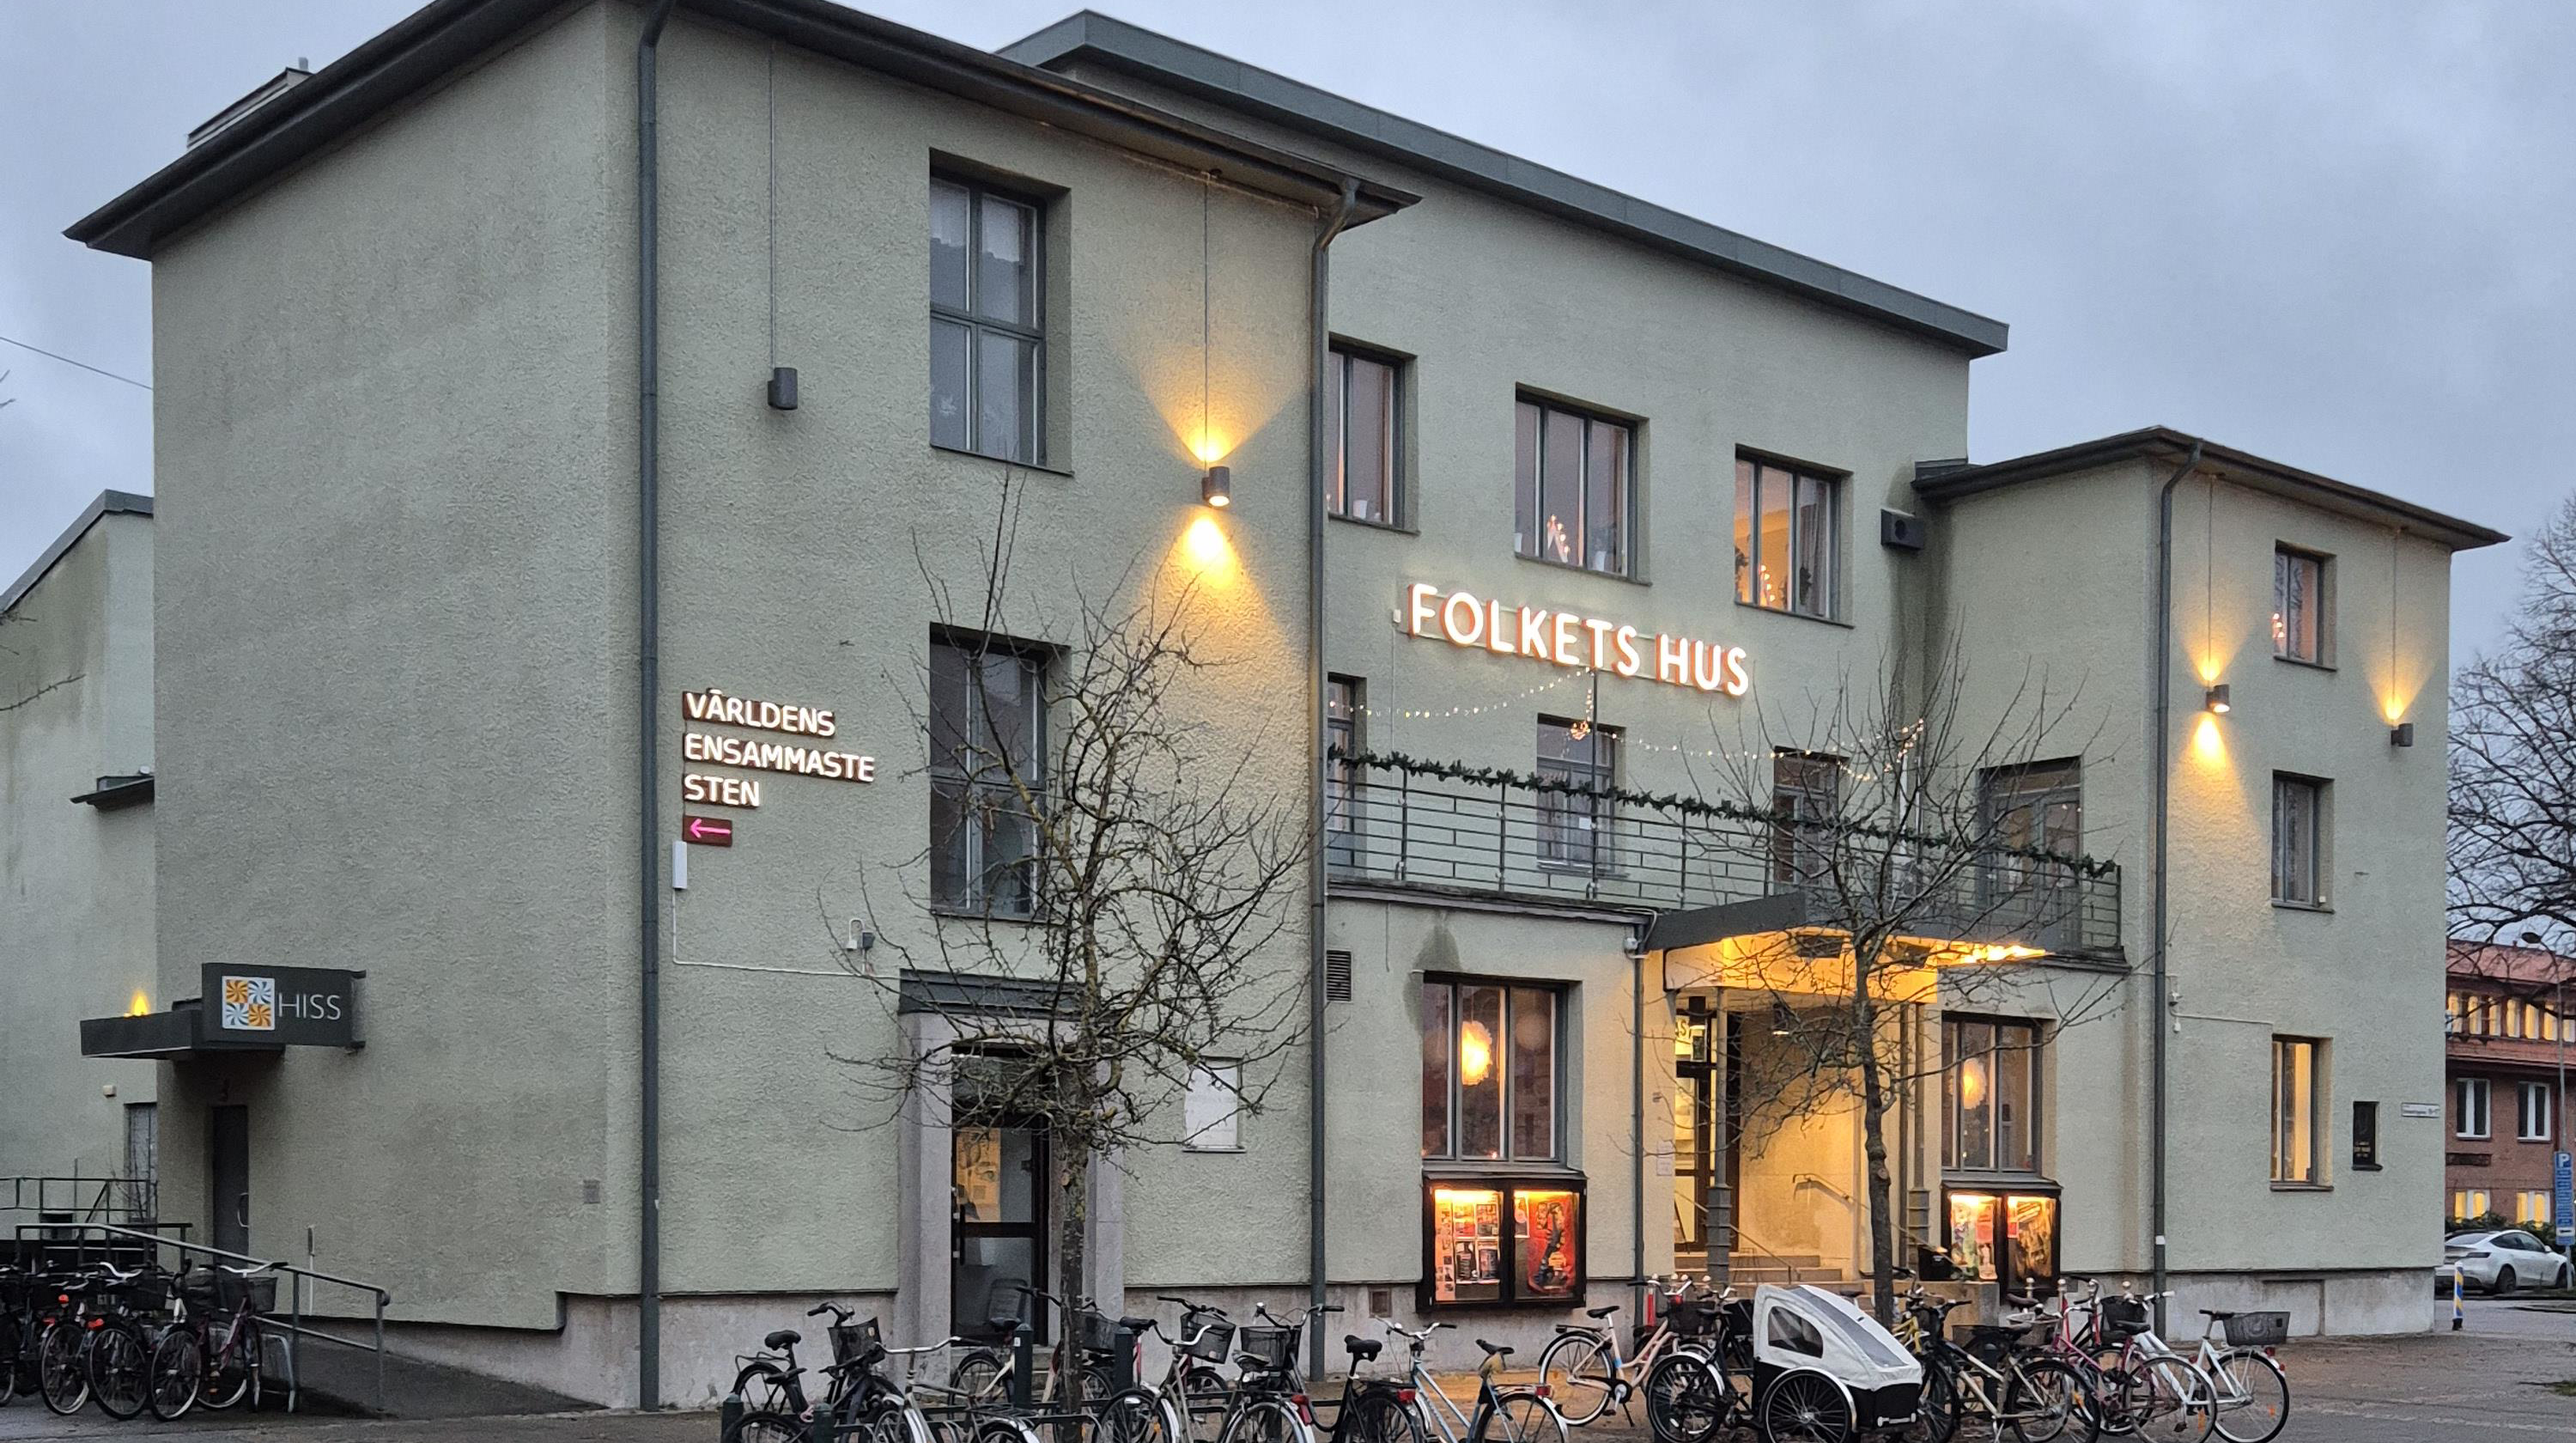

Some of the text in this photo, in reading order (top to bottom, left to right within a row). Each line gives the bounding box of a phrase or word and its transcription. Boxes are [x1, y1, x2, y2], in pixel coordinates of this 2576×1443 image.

[1409, 582, 1749, 697] FOLKETS HUS
[685, 688, 835, 737] VÄRLDENS
[684, 733, 875, 782] ENSAMMASTE
[684, 774, 760, 807] STEN
[278, 992, 342, 1020] HISS
[2559, 1154, 2569, 1167] P
